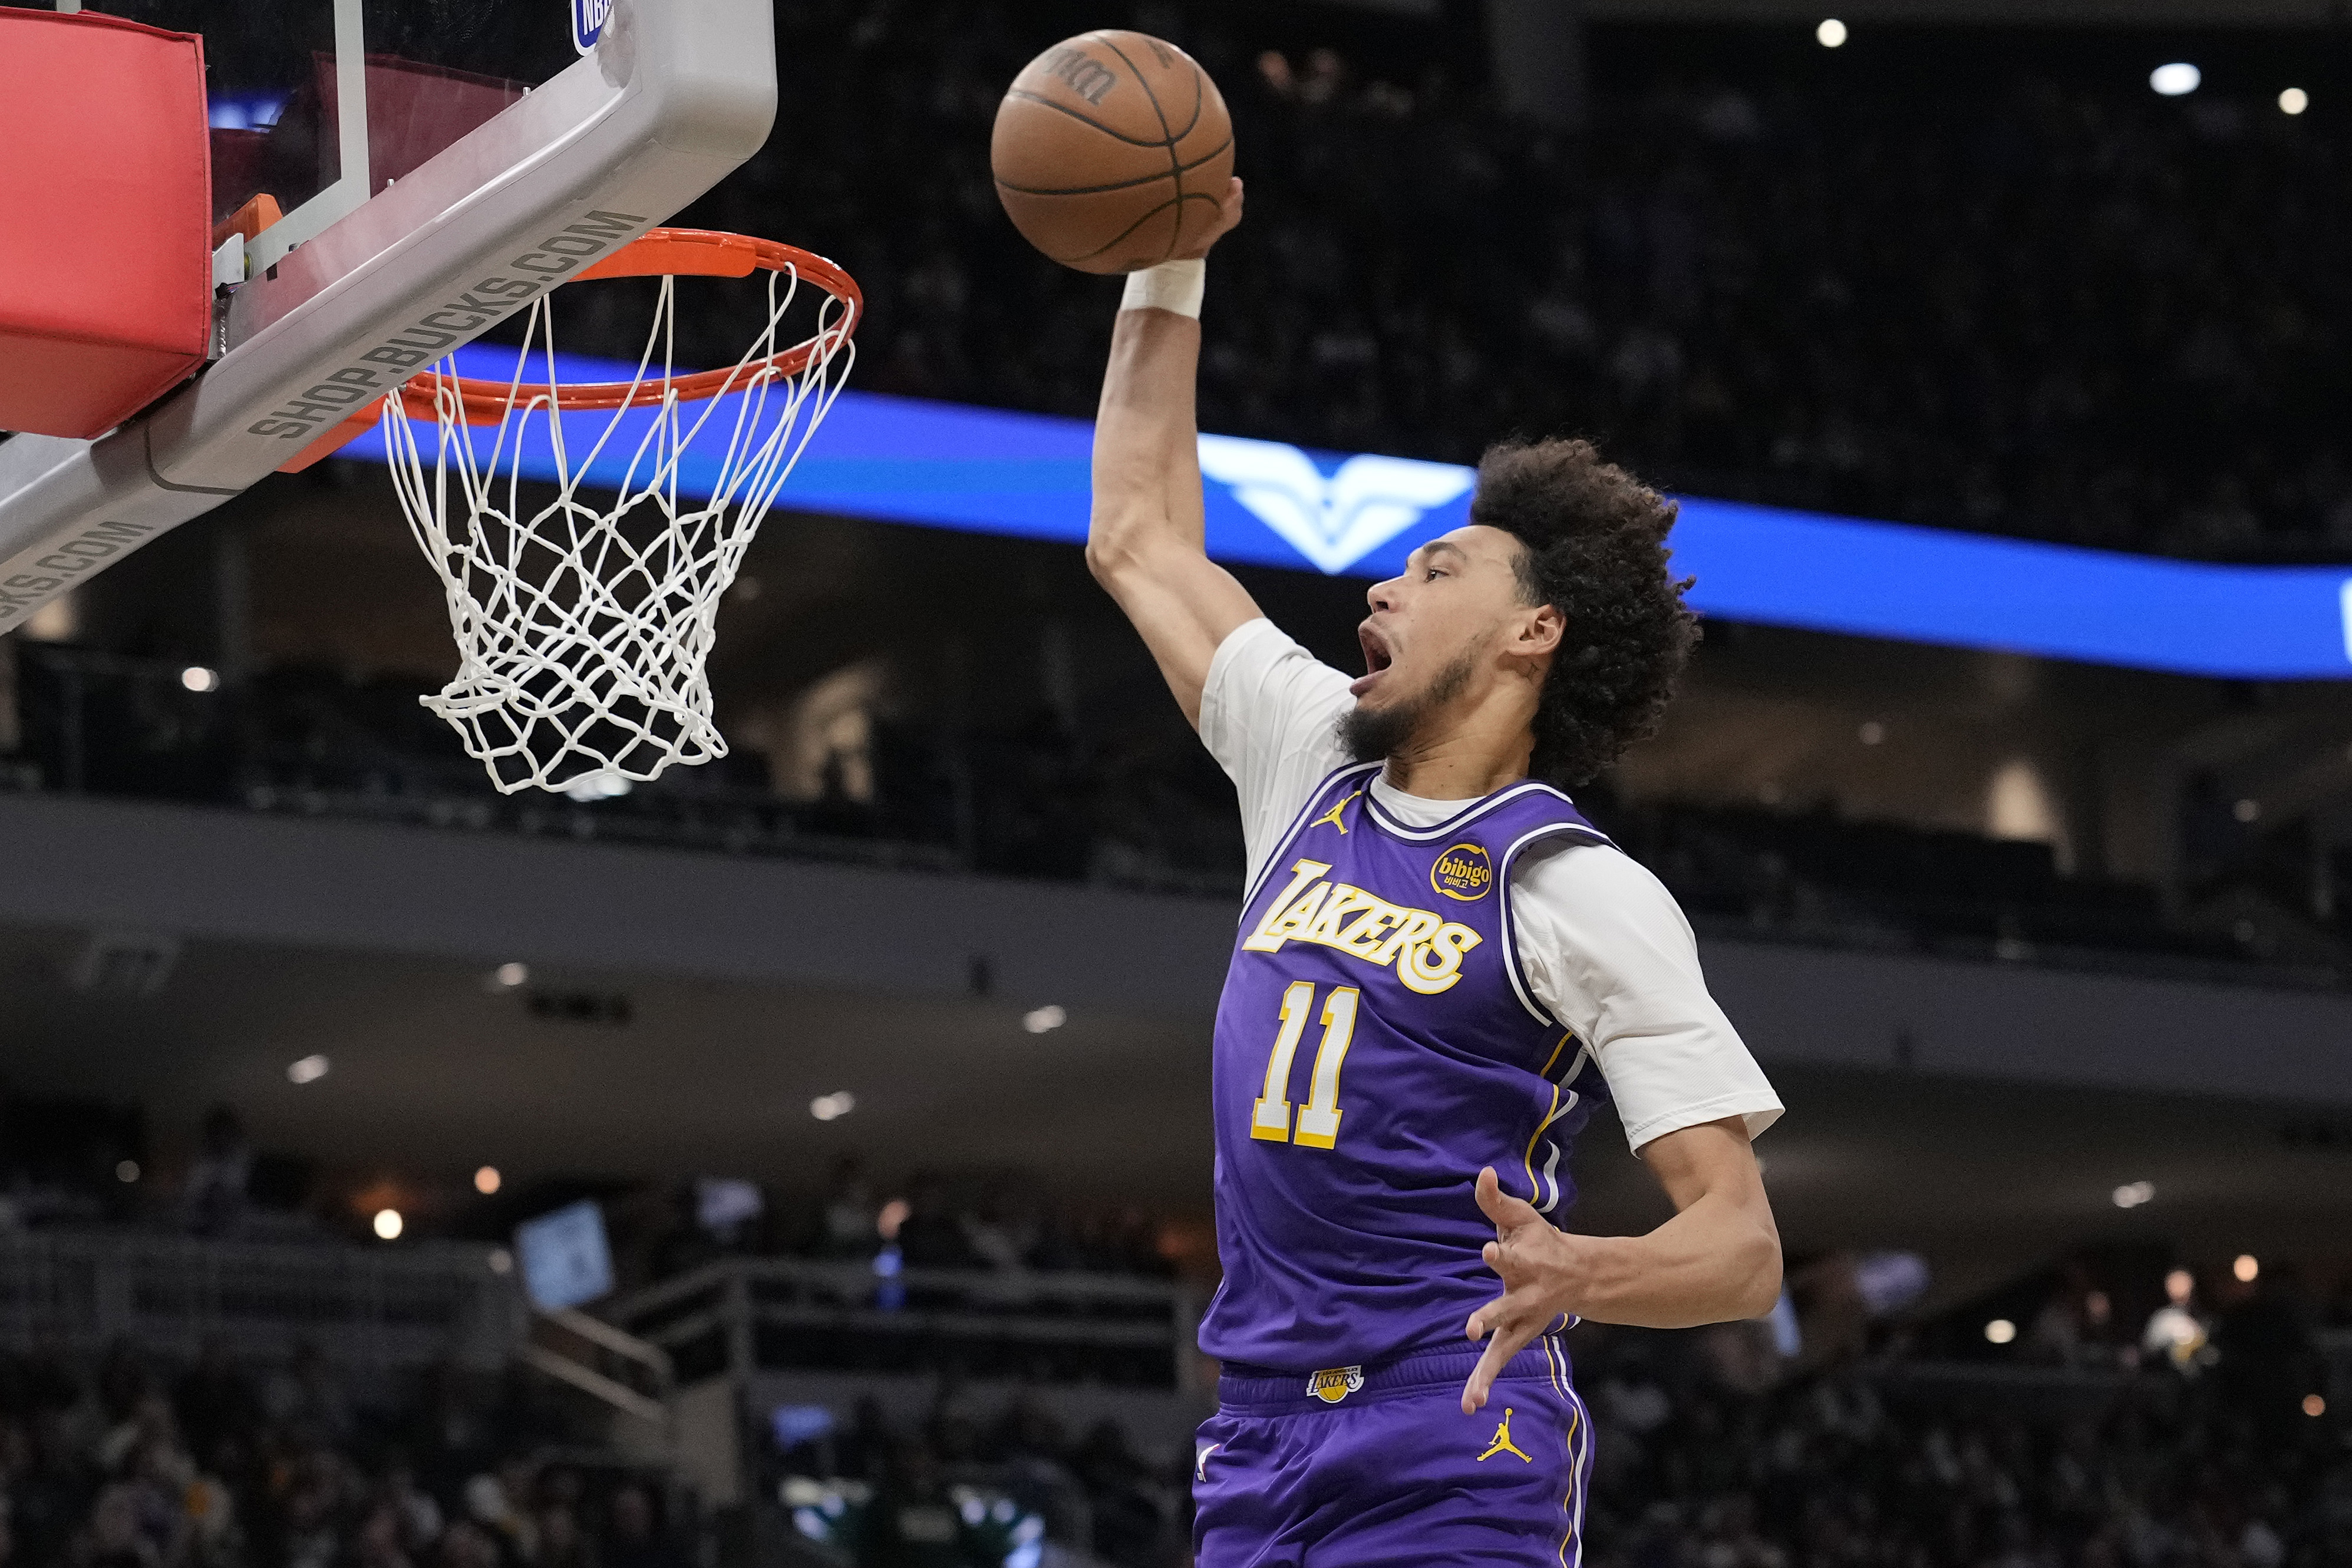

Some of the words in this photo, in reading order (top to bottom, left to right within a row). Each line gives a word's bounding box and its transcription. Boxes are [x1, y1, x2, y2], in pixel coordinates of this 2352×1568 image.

[248, 209, 648, 440] SHOP.BUCKS.COM
[1439, 857, 1489, 887] bibigo
[1444, 876, 1467, 889] 비비고
[1242, 859, 1483, 995] LAKERS
[1251, 981, 1360, 1150] 11
[1308, 1372, 1361, 1393] LAKERS
